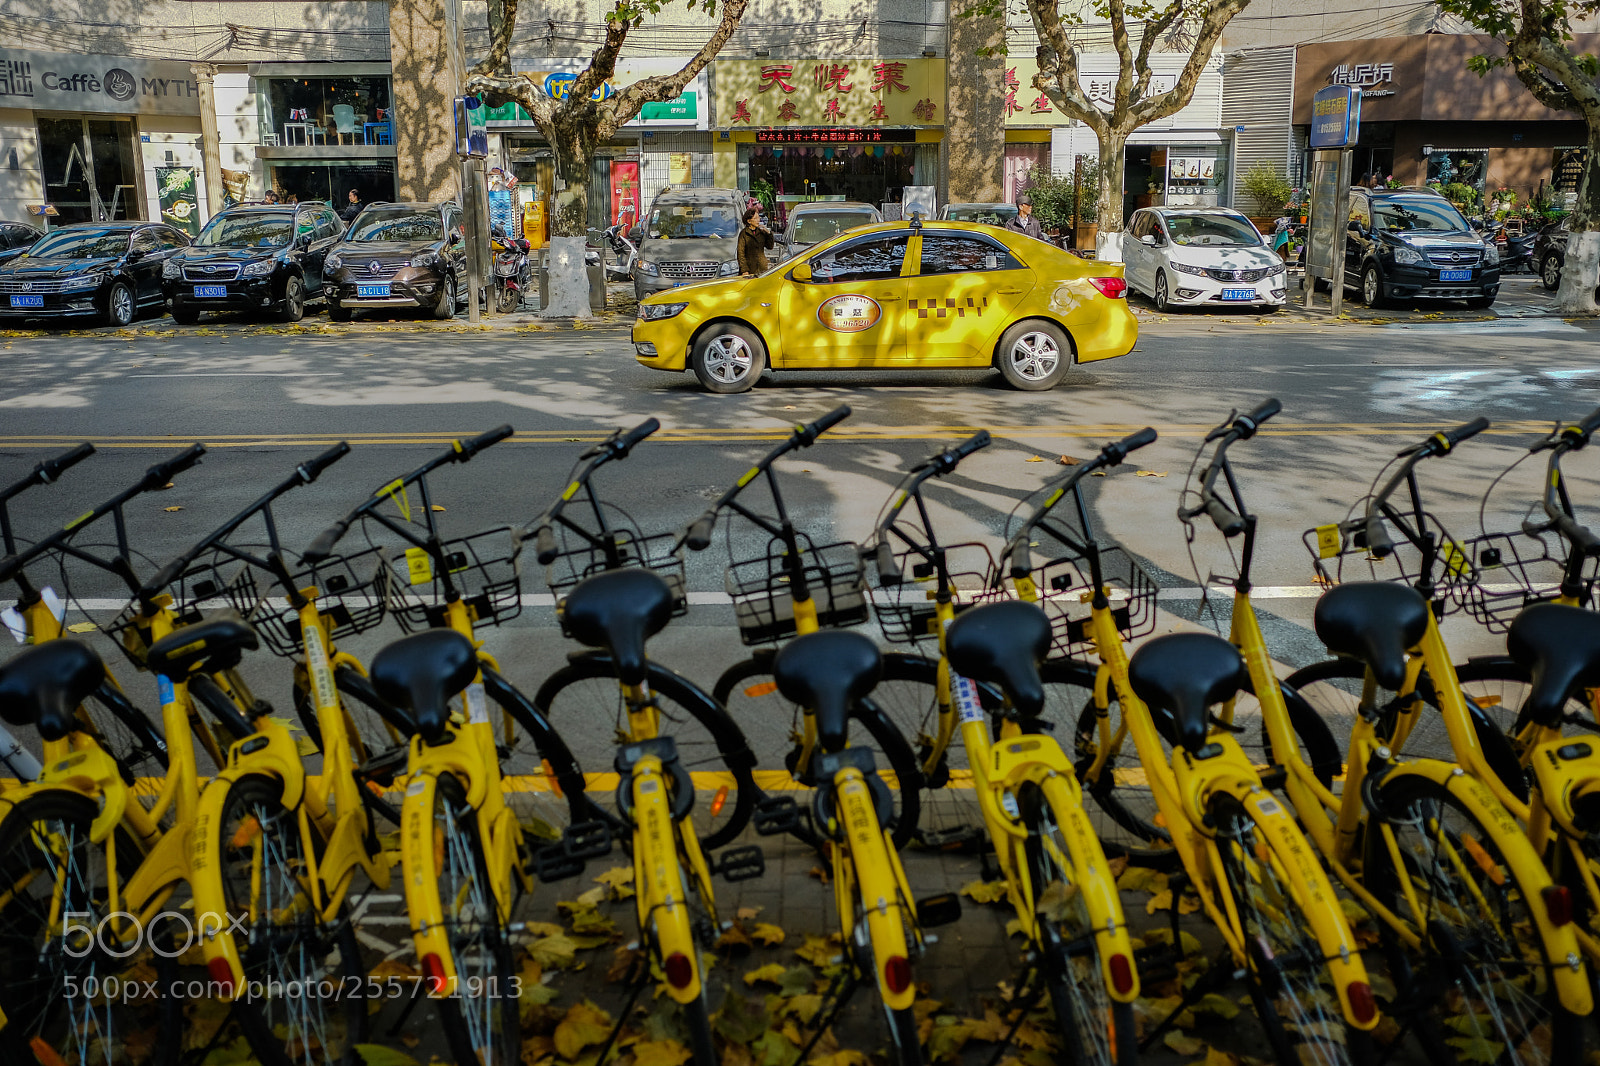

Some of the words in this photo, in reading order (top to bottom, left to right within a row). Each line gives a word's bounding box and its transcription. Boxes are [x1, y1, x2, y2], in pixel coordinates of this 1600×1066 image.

[41, 71, 101, 93] Caffè
[758, 61, 911, 94] 天悦莱
[730, 97, 937, 124] 美容养生馆
